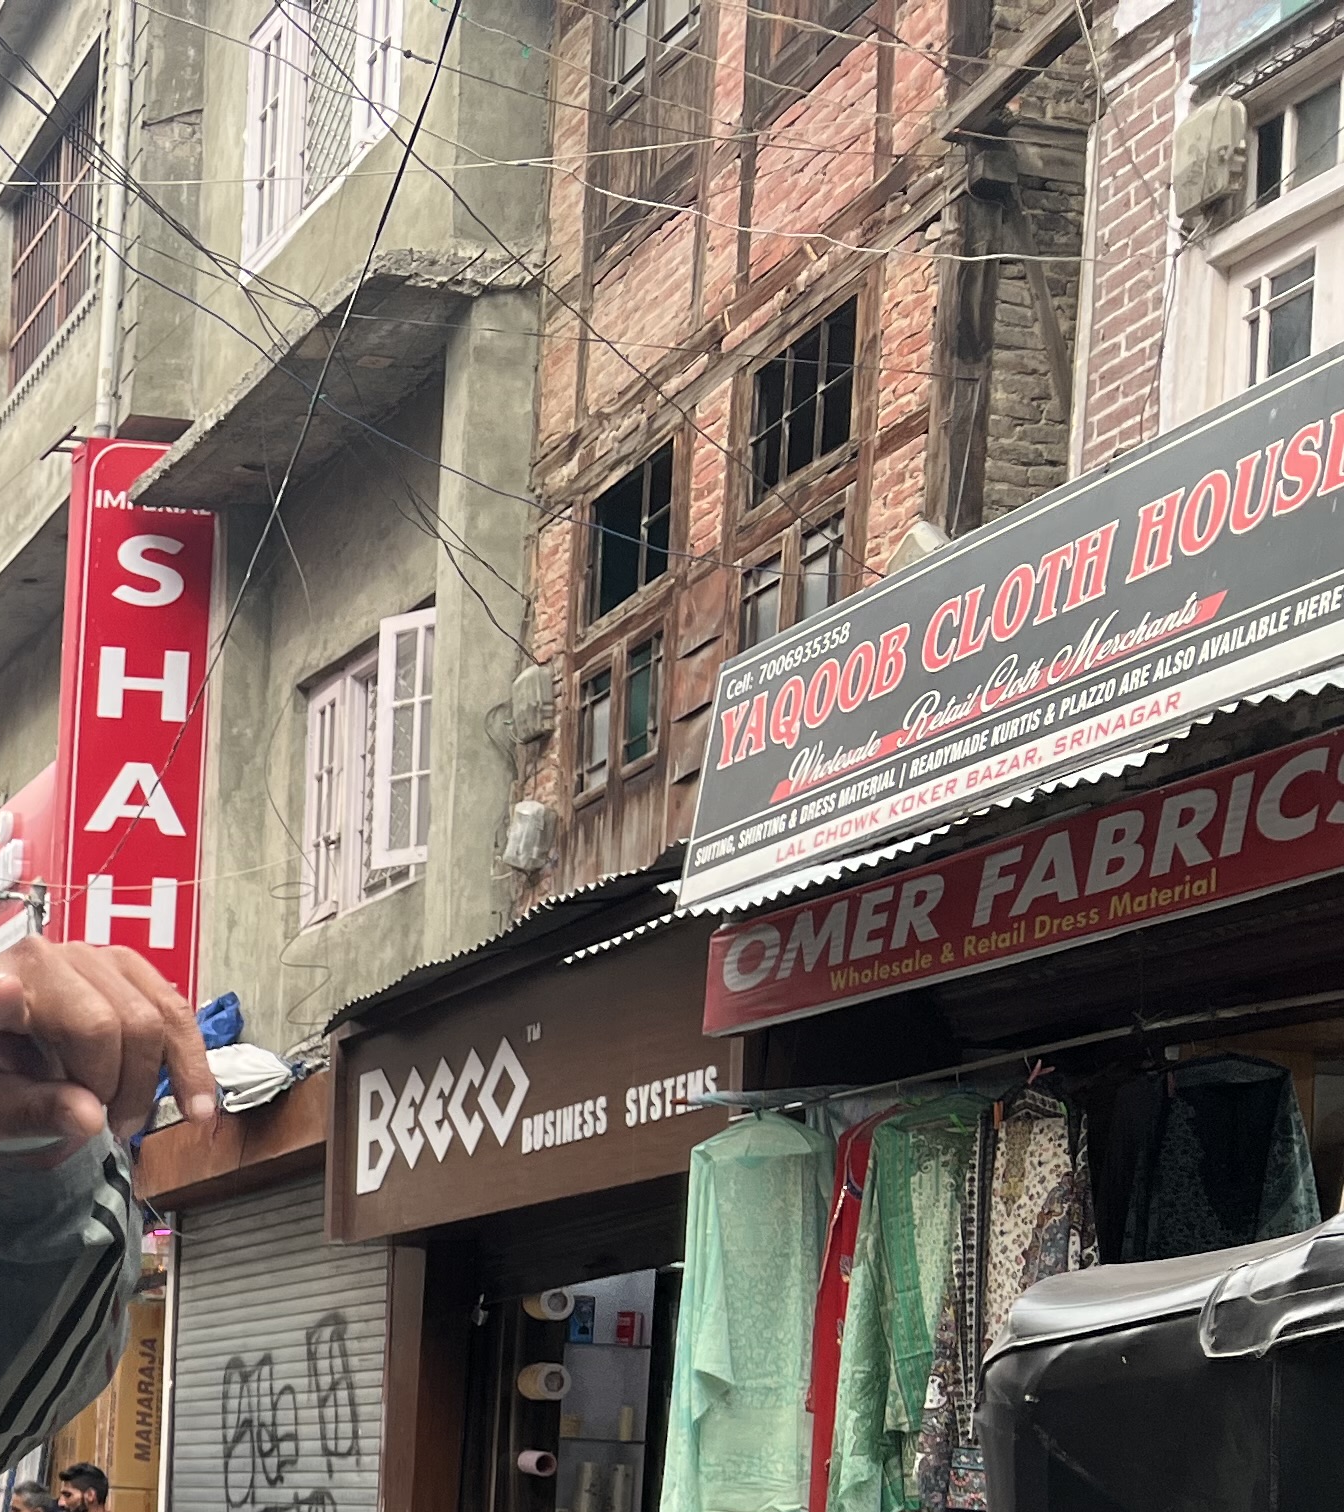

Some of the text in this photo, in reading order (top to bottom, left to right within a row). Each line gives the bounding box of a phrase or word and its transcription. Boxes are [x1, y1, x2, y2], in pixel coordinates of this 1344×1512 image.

[717, 622, 911, 770] YAQOOB
[921, 518, 1120, 673] CLOTH
[726, 620, 851, 701] Cell: 7006935358
[788, 590, 1203, 795] Wholesale Retail Cloth Merchants
[83, 534, 191, 950] SHAH
[694, 838, 736, 867] SUITING,
[738, 815, 788, 849] SHIRTING
[788, 811, 797, 830] &
[799, 796, 836, 825] DRESS
[838, 774, 896, 810] MATERIAL
[909, 728, 989, 780] READYMADE
[991, 706, 1043, 747] KURTIS
[1044, 703, 1055, 725] &
[1058, 677, 1115, 721] PLAZZO
[1118, 663, 1150, 696] ARE
[1153, 645, 1195, 682] ALSO
[1198, 610, 1290, 665] AVAILABLE
[1294, 586, 1344, 627] HERE
[775, 690, 1183, 864] LAL CHOWK KOKER BAZAR, SRINAGAR
[721, 873, 947, 993] OMER
[830, 866, 1218, 993] Wholesale & Retail Dress Material
[356, 1035, 531, 1196] BEECO
[520, 1064, 720, 1156] BUSINESS SYSTEMS
[134, 1337, 158, 1463] MAHARAJA
